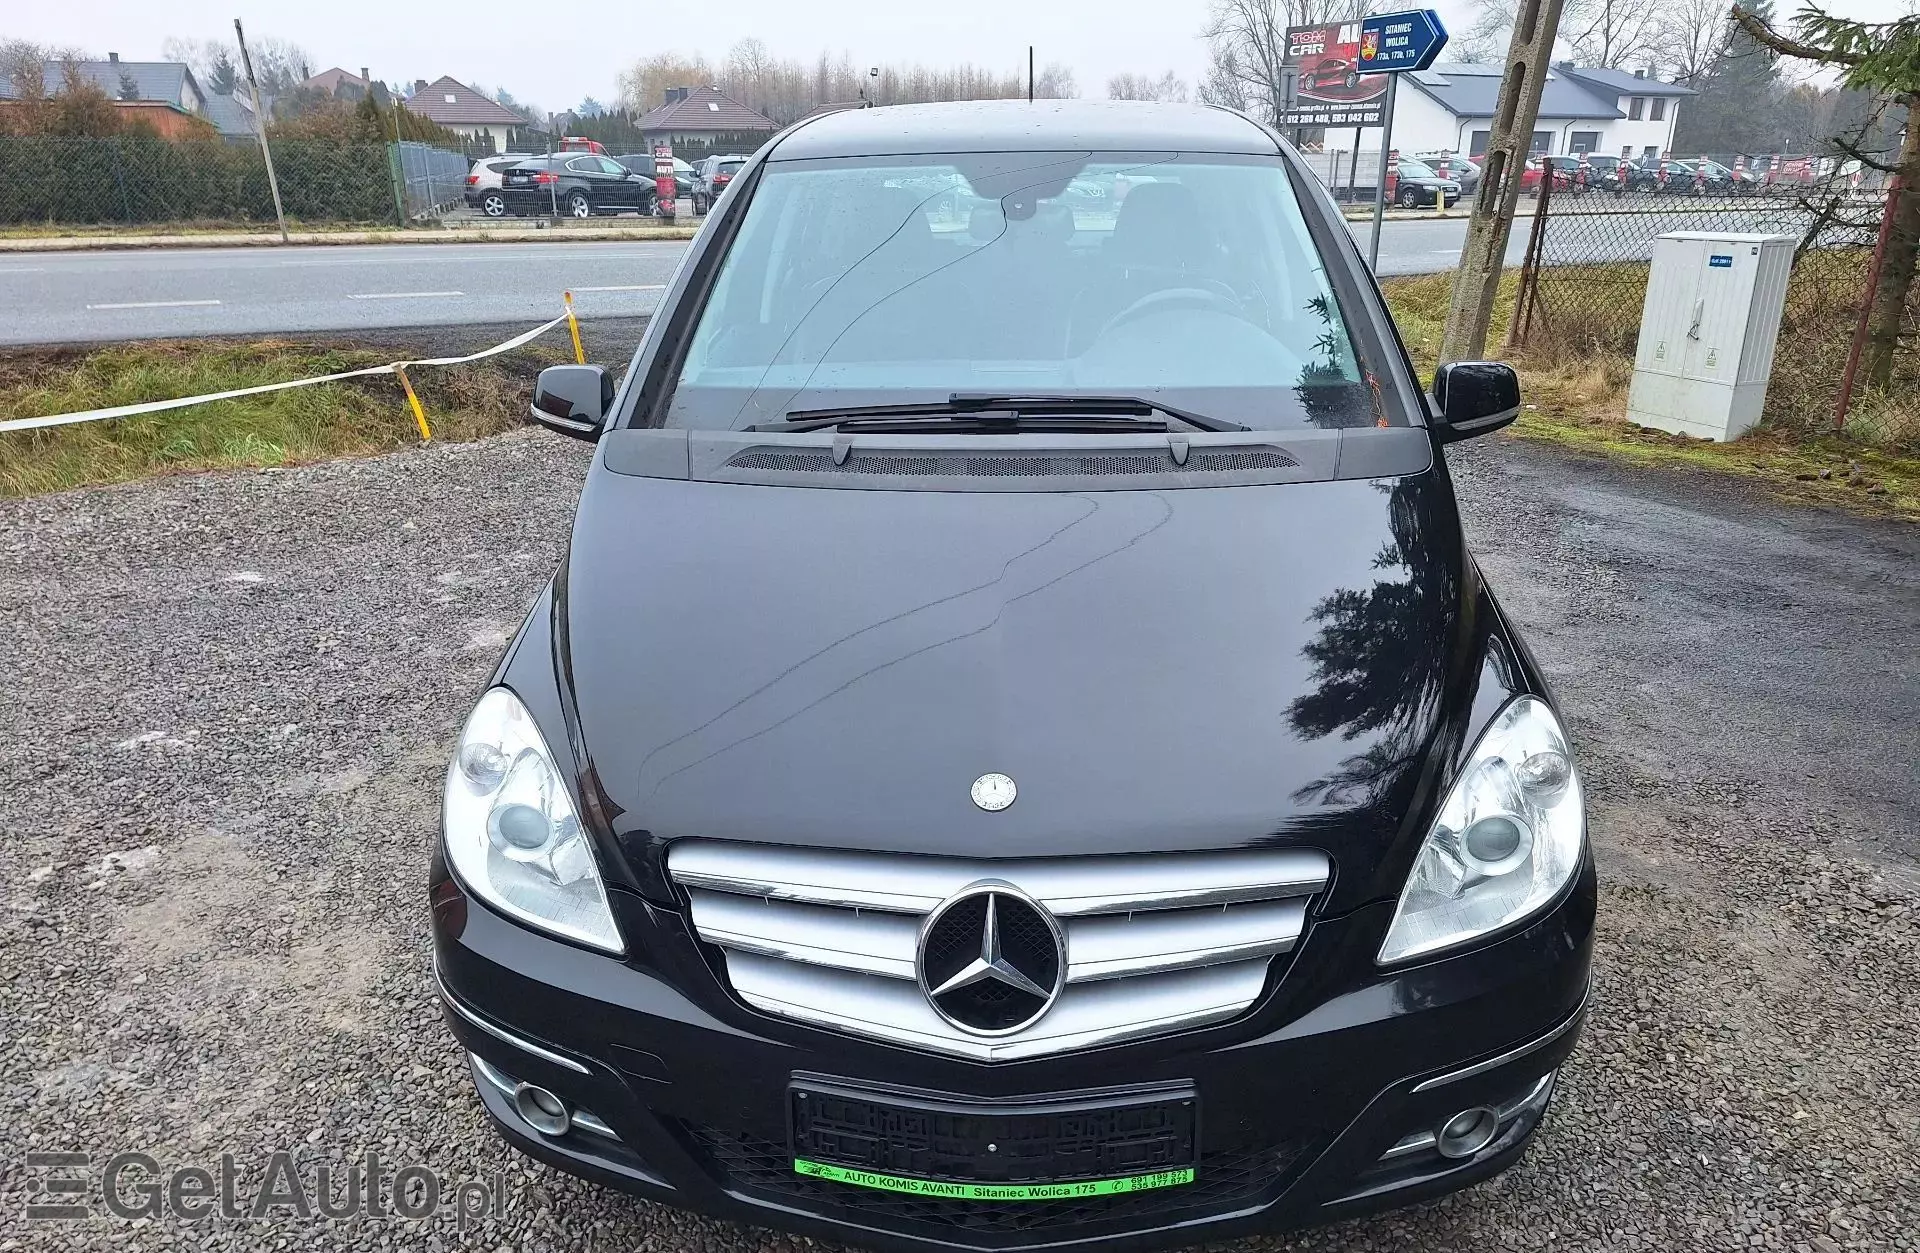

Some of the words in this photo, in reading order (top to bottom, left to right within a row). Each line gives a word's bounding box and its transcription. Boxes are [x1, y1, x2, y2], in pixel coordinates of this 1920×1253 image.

[1385, 23, 1412, 34] SITANIEC
[1290, 30, 1326, 44] TOM
[1386, 36, 1408, 47] WOLICA
[1290, 43, 1324, 56] CAR
[1406, 49, 1415, 58] 175
[844, 1171, 876, 1185] AUTO
[879, 1177, 918, 1191] KOMIS
[921, 1183, 965, 1195] AVANTI
[973, 1187, 1024, 1198] Sitaniec
[1028, 1187, 1071, 1197] Wolica
[1075, 1184, 1096, 1194] 175
